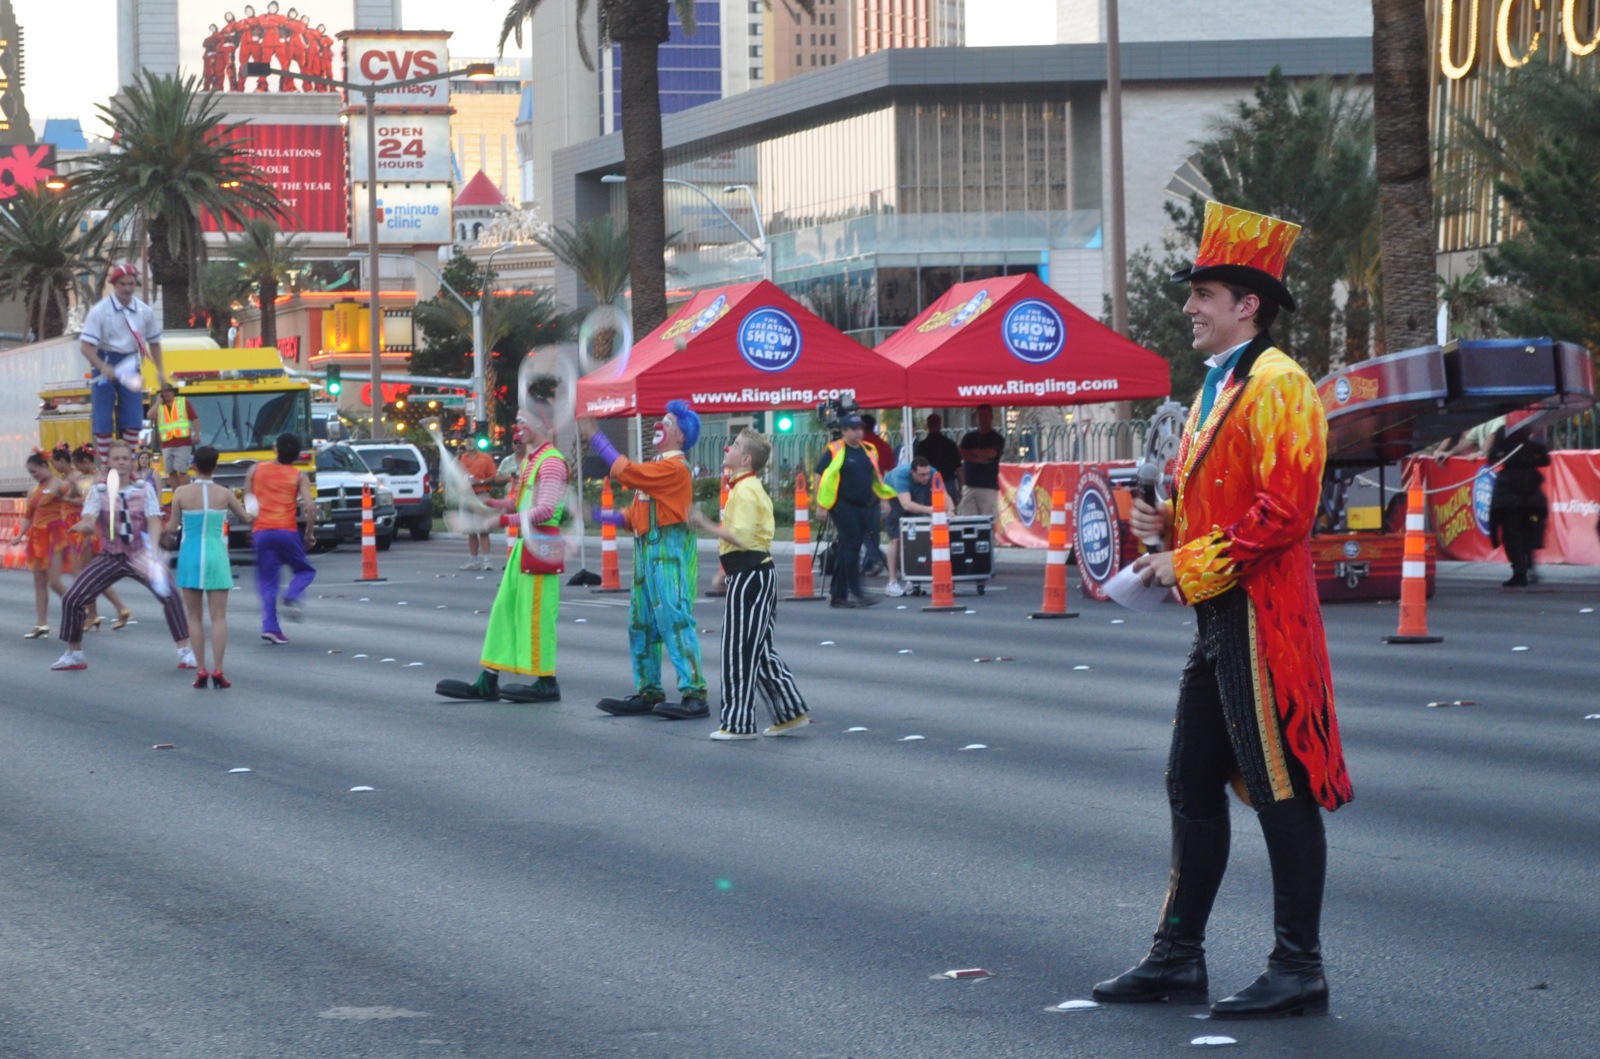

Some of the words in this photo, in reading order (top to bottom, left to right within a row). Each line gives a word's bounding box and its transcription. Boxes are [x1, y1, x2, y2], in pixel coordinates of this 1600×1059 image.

[360, 50, 438, 81] CVS
[362, 83, 437, 97] armacy
[378, 126, 423, 137] OPEN
[378, 138, 426, 159] 24
[266, 165, 290, 174] OUR
[378, 160, 424, 169] HOURS
[281, 182, 302, 191] THE
[303, 182, 332, 191] YEAR
[394, 203, 440, 216] minute
[386, 215, 423, 229] clinic
[750, 322, 792, 335] GREATEST
[1011, 322, 1057, 338] SHOW
[746, 330, 793, 347] SHOW
[1013, 338, 1054, 352] EARTH
[748, 346, 790, 361] EARTH
[957, 378, 1119, 397] www.Ringling.com
[691, 387, 857, 404] www.Ringling.com
[1083, 520, 1108, 543] SHOW
[1086, 545, 1110, 565] EARTH
